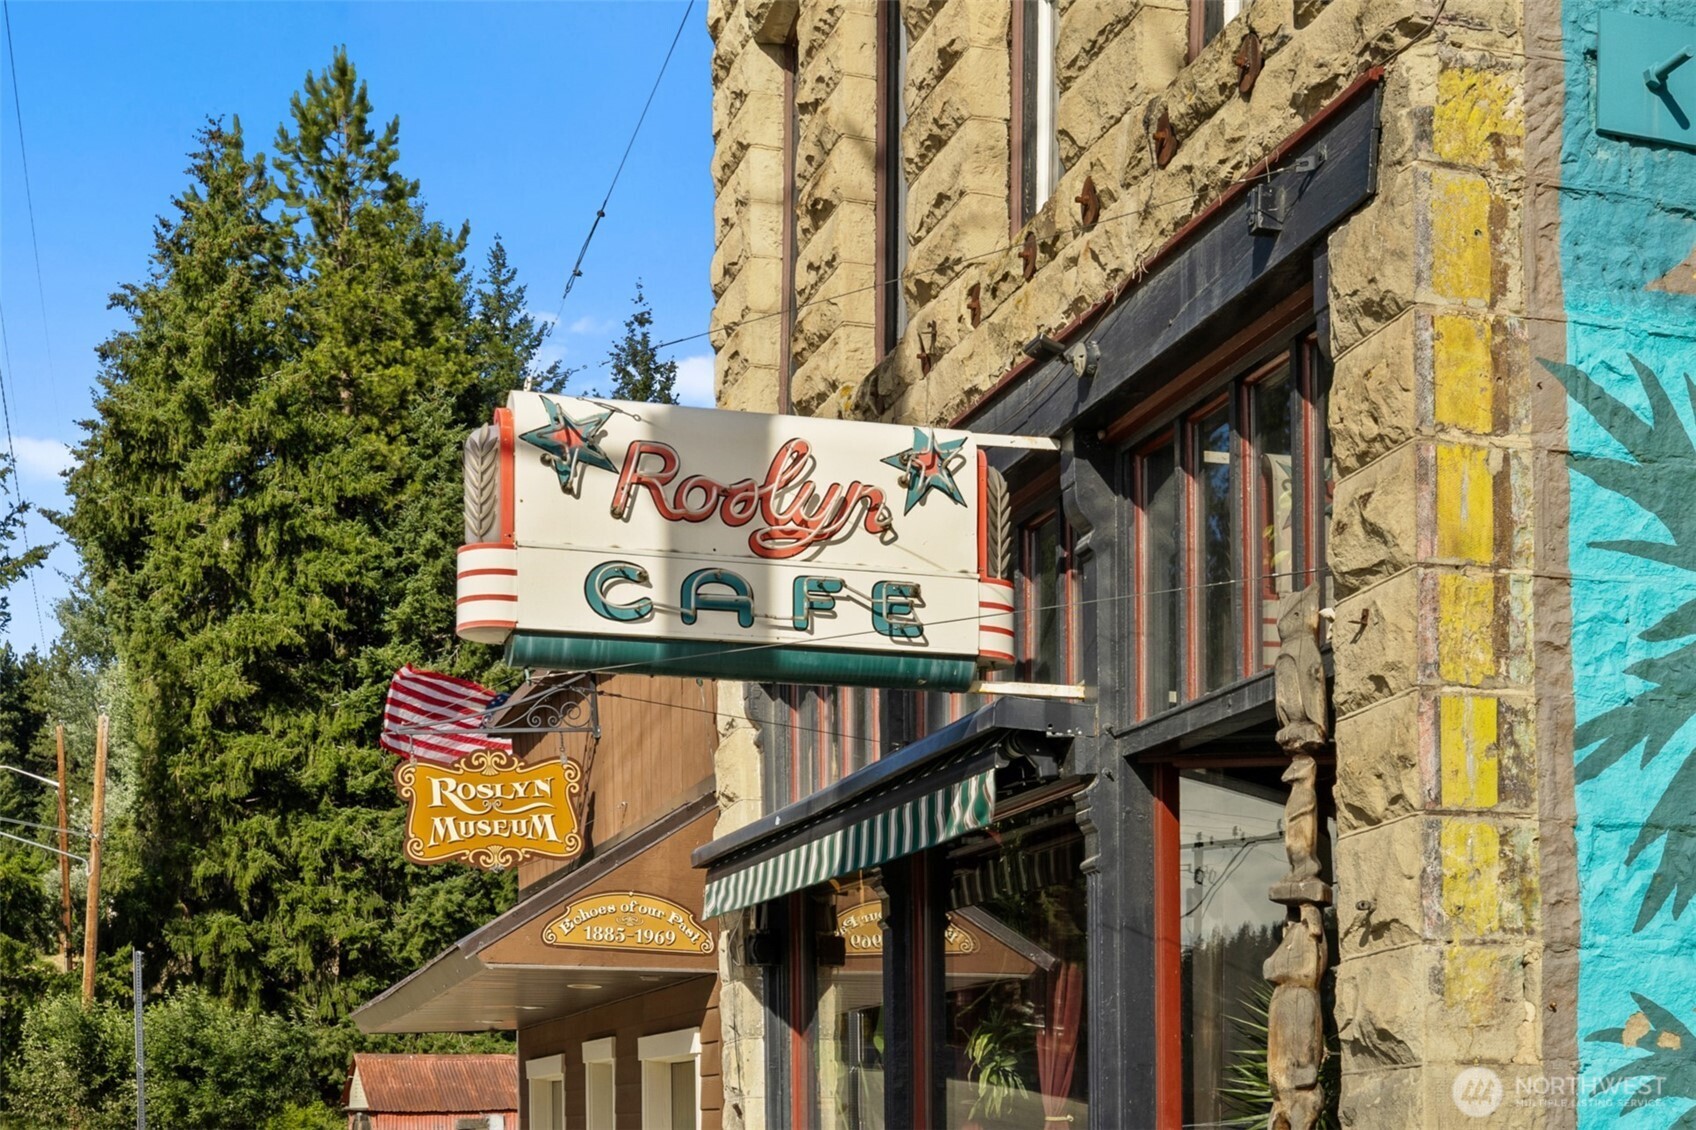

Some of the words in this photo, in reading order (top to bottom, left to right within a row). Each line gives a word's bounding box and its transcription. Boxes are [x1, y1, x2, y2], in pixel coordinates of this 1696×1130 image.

[612, 438, 891, 558] Roslyn
[583, 560, 924, 638] CAFE
[426, 776, 554, 814] ROSLYN
[427, 813, 563, 848] MUSEUM
[558, 904, 616, 936] Echoes
[620, 900, 639, 914] of
[638, 905, 665, 918] our
[667, 911, 702, 944] Past
[583, 925, 676, 946] 1885-1969
